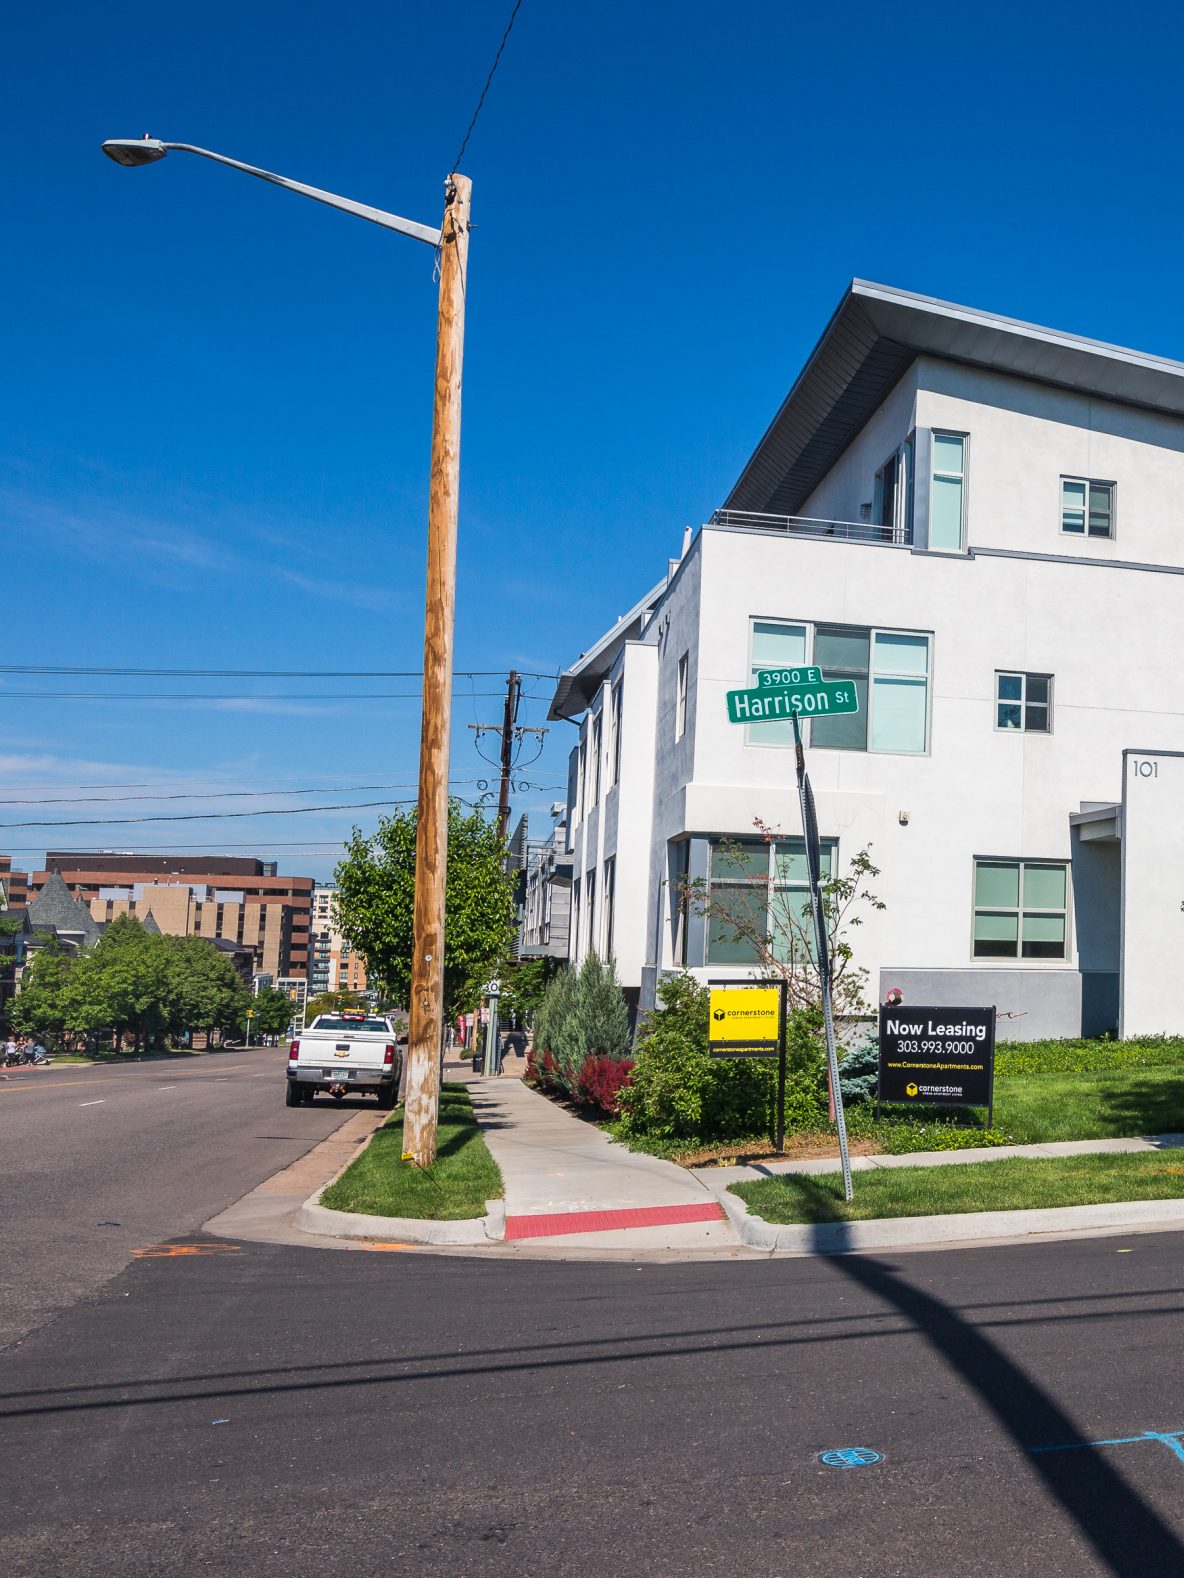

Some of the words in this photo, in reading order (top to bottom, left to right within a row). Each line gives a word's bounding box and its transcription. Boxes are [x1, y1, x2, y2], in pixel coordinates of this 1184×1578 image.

[763, 670, 800, 685] 3900
[807, 669, 817, 682] E
[734, 690, 830, 718] Harrison
[835, 691, 850, 703] St
[1133, 760, 1159, 778] 101
[727, 1009, 776, 1017] cornerstone
[886, 1020, 924, 1036] Now
[927, 1020, 986, 1041] Leasing
[897, 1040, 975, 1054] 303.993.9000
[887, 1061, 984, 1071] www.CornerstoneApartments.com
[918, 1085, 963, 1093] cornerstone
